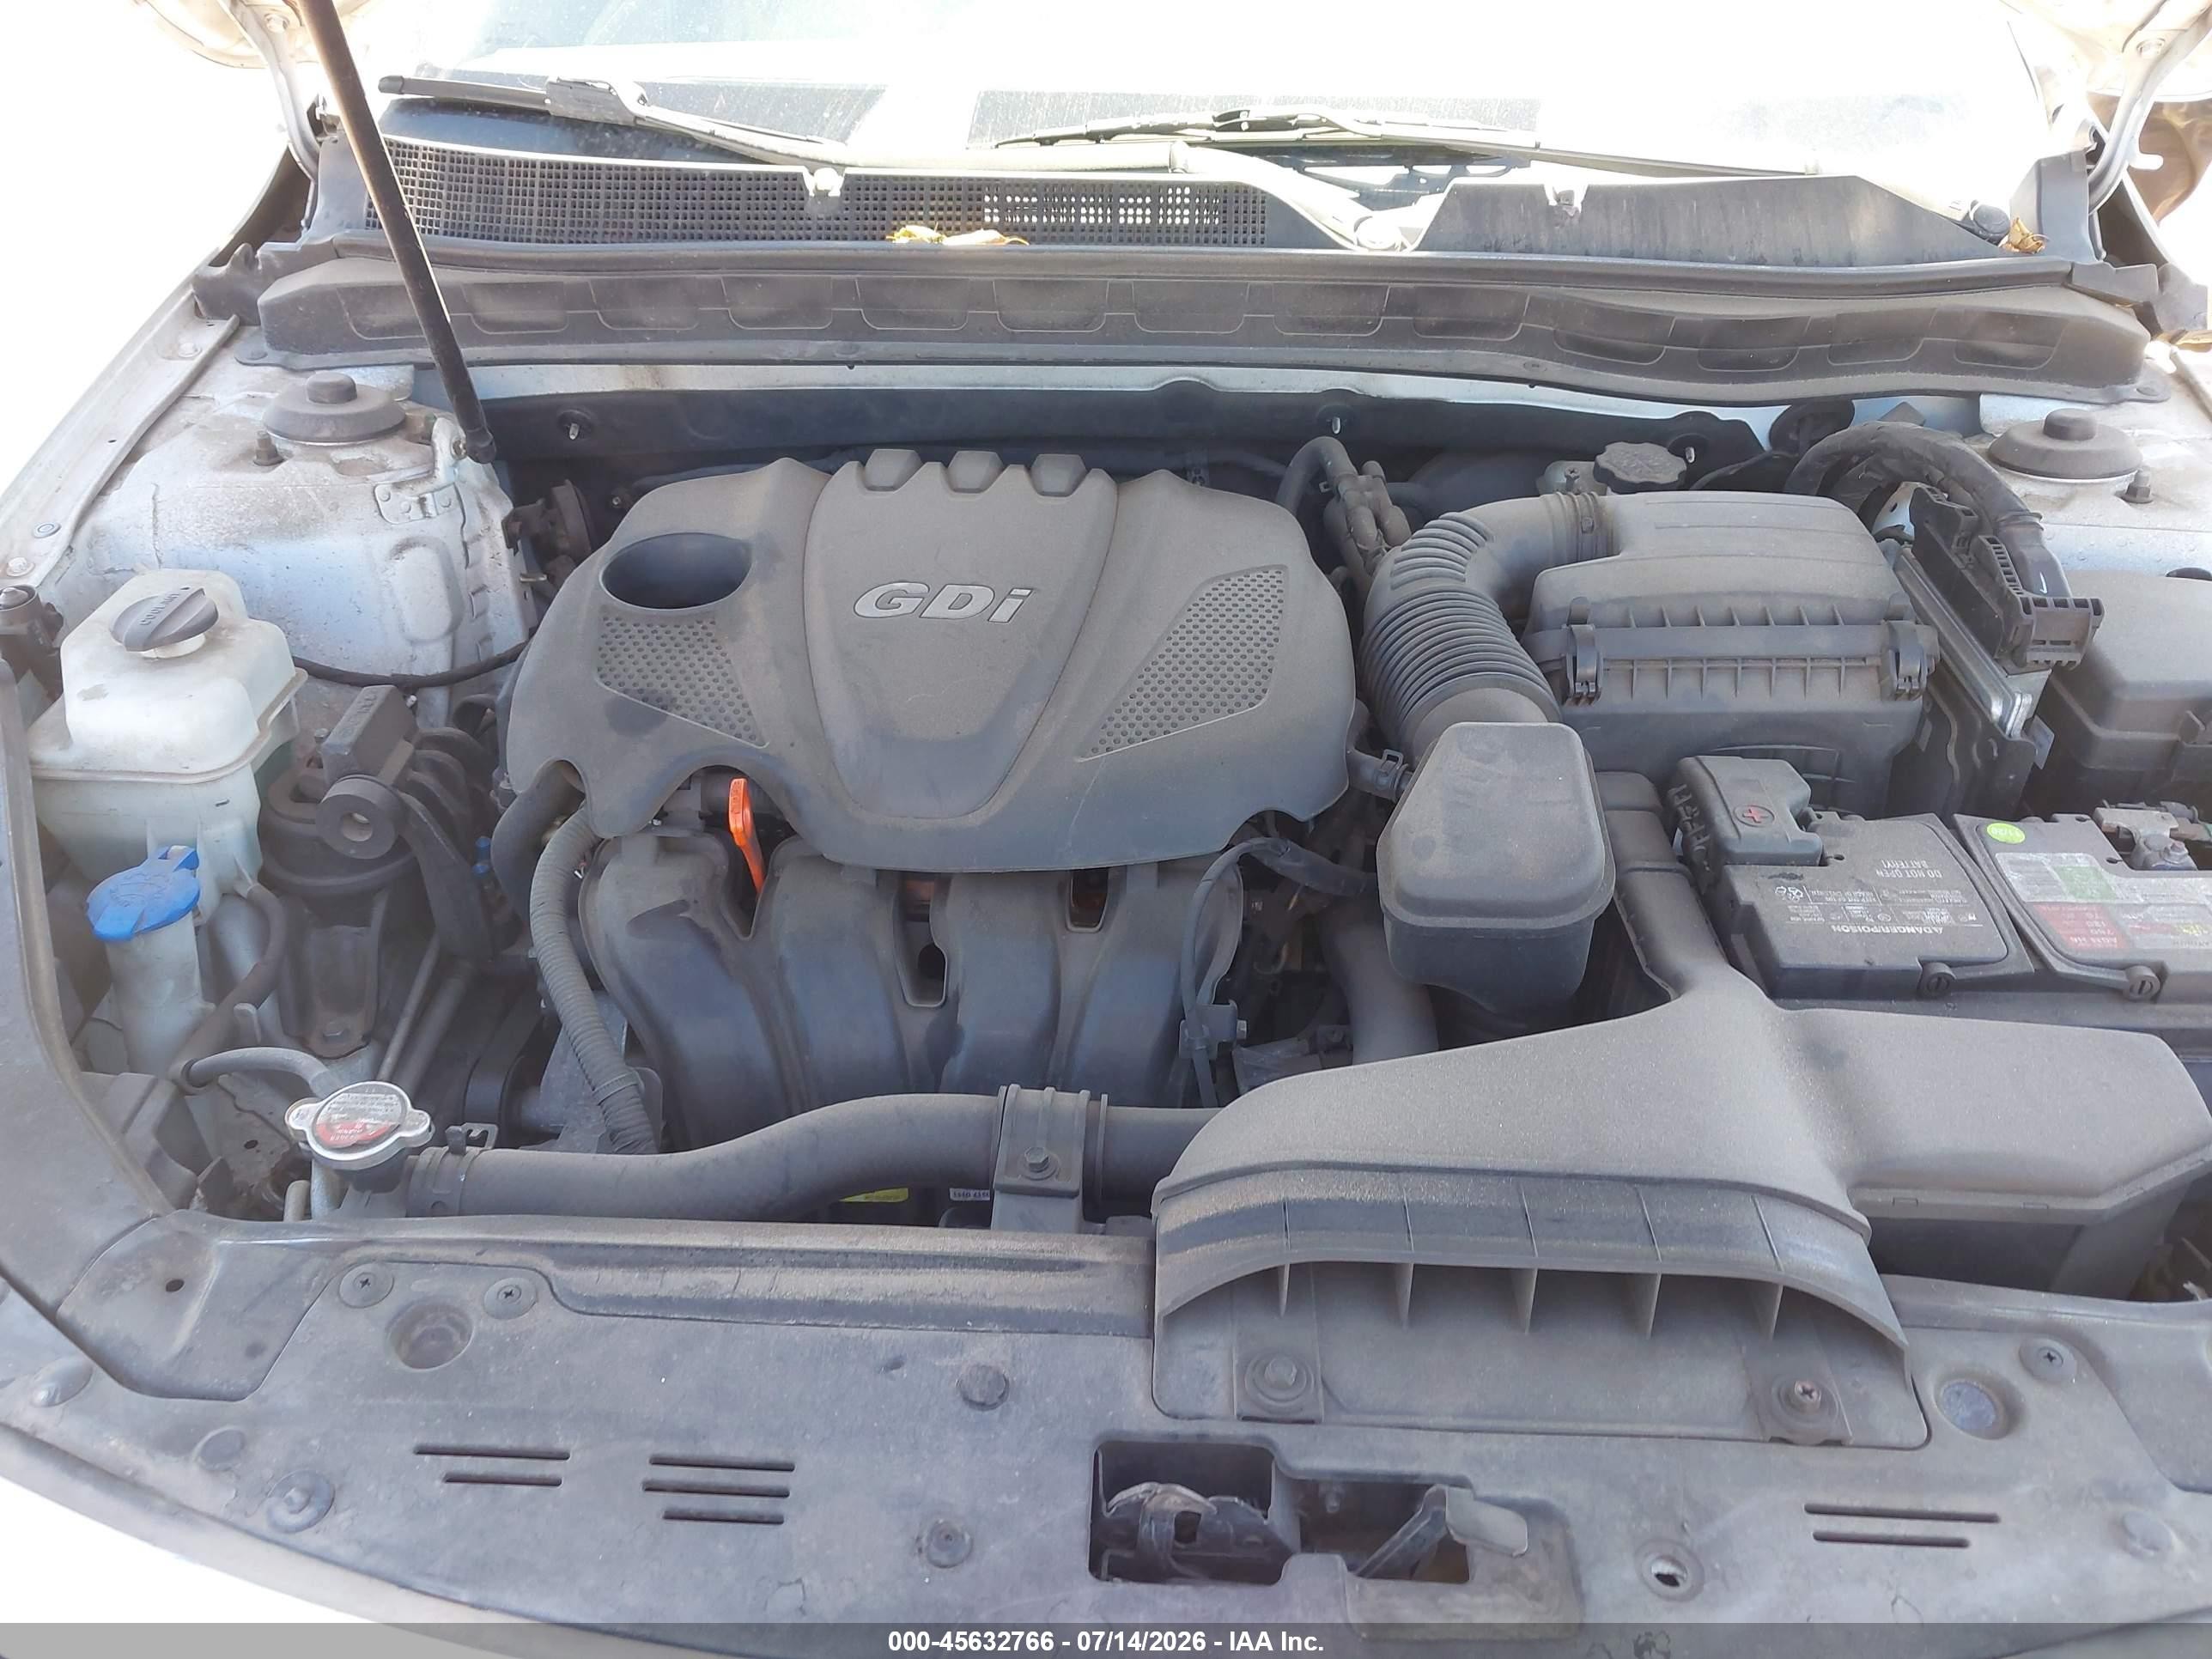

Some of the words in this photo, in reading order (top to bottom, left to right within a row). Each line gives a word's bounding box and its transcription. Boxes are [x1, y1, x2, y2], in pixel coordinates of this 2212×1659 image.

[854, 580, 1034, 624] GDi
[1875, 869, 1904, 878] OPEN
[1905, 869, 1926, 878] NOT
[1926, 870, 1942, 878] DO
